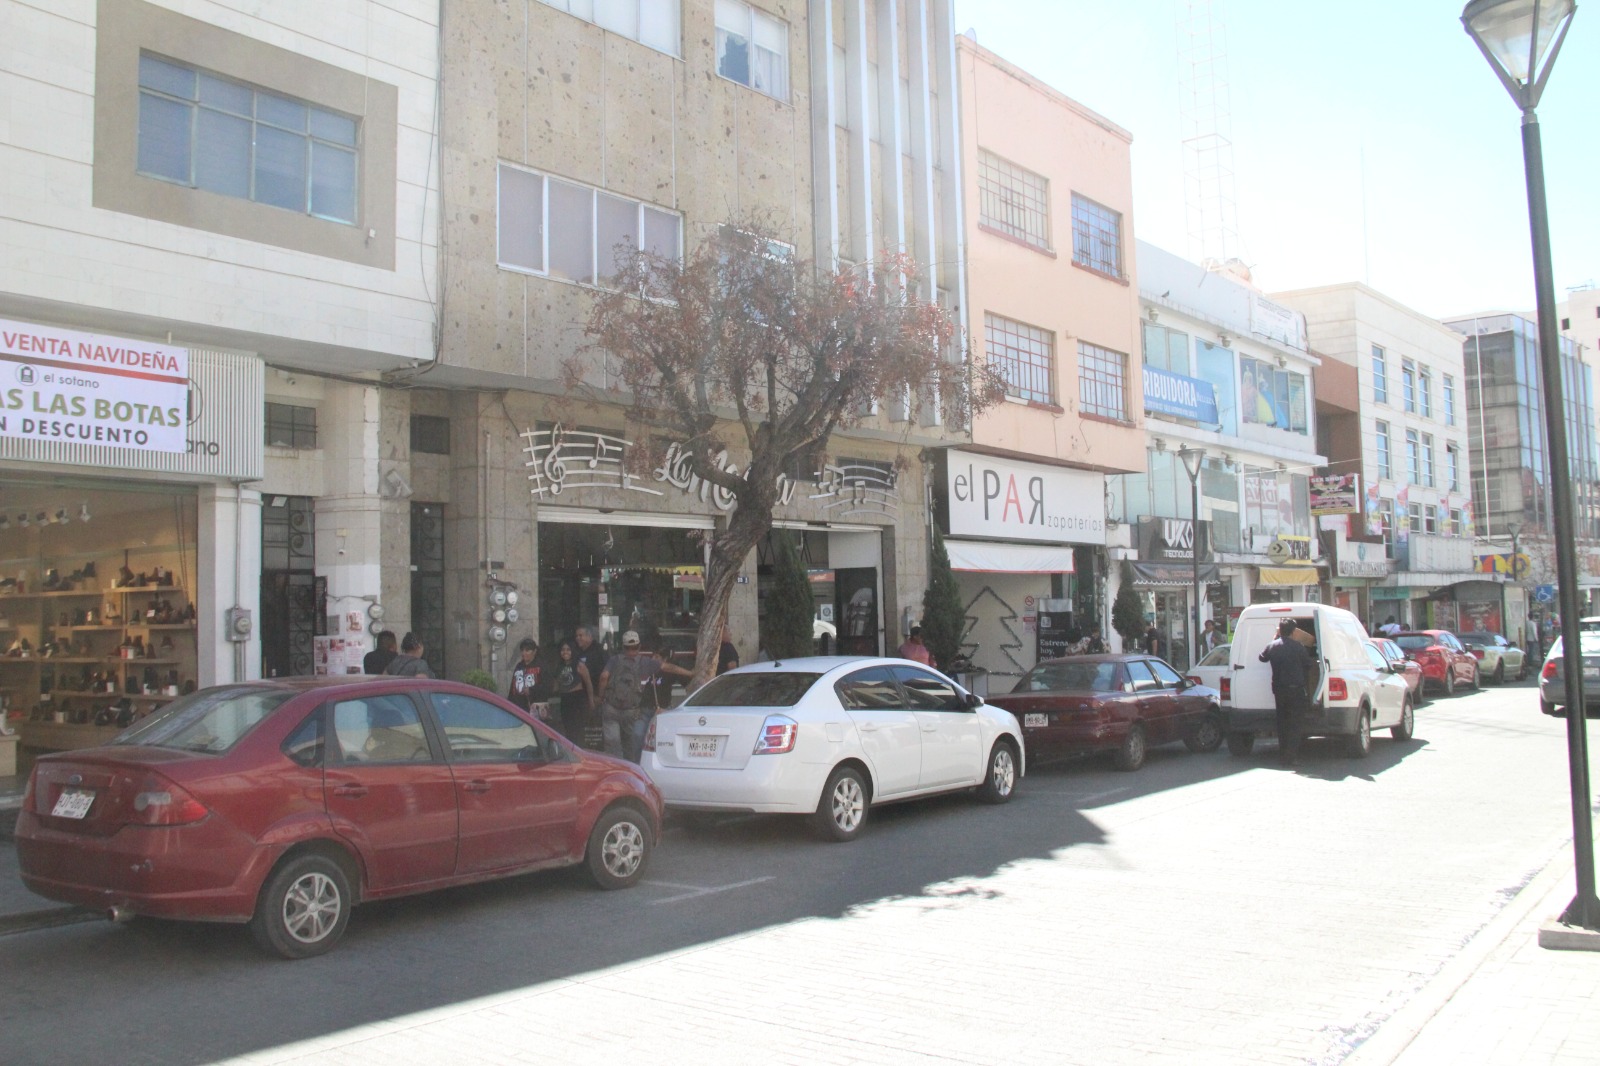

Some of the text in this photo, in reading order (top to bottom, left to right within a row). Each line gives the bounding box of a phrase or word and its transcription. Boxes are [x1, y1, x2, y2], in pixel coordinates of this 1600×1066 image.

[3, 331, 179, 372] VENTA NAVIDEÑA
[44, 373, 100, 389] el sotano
[0, 388, 181, 428] S LAS BOTAS
[22, 418, 149, 445] DESCUENTO
[954, 464, 1045, 525] el PAR
[1048, 514, 1102, 532] zapaterias
[1040, 639, 1069, 647] Estrena
